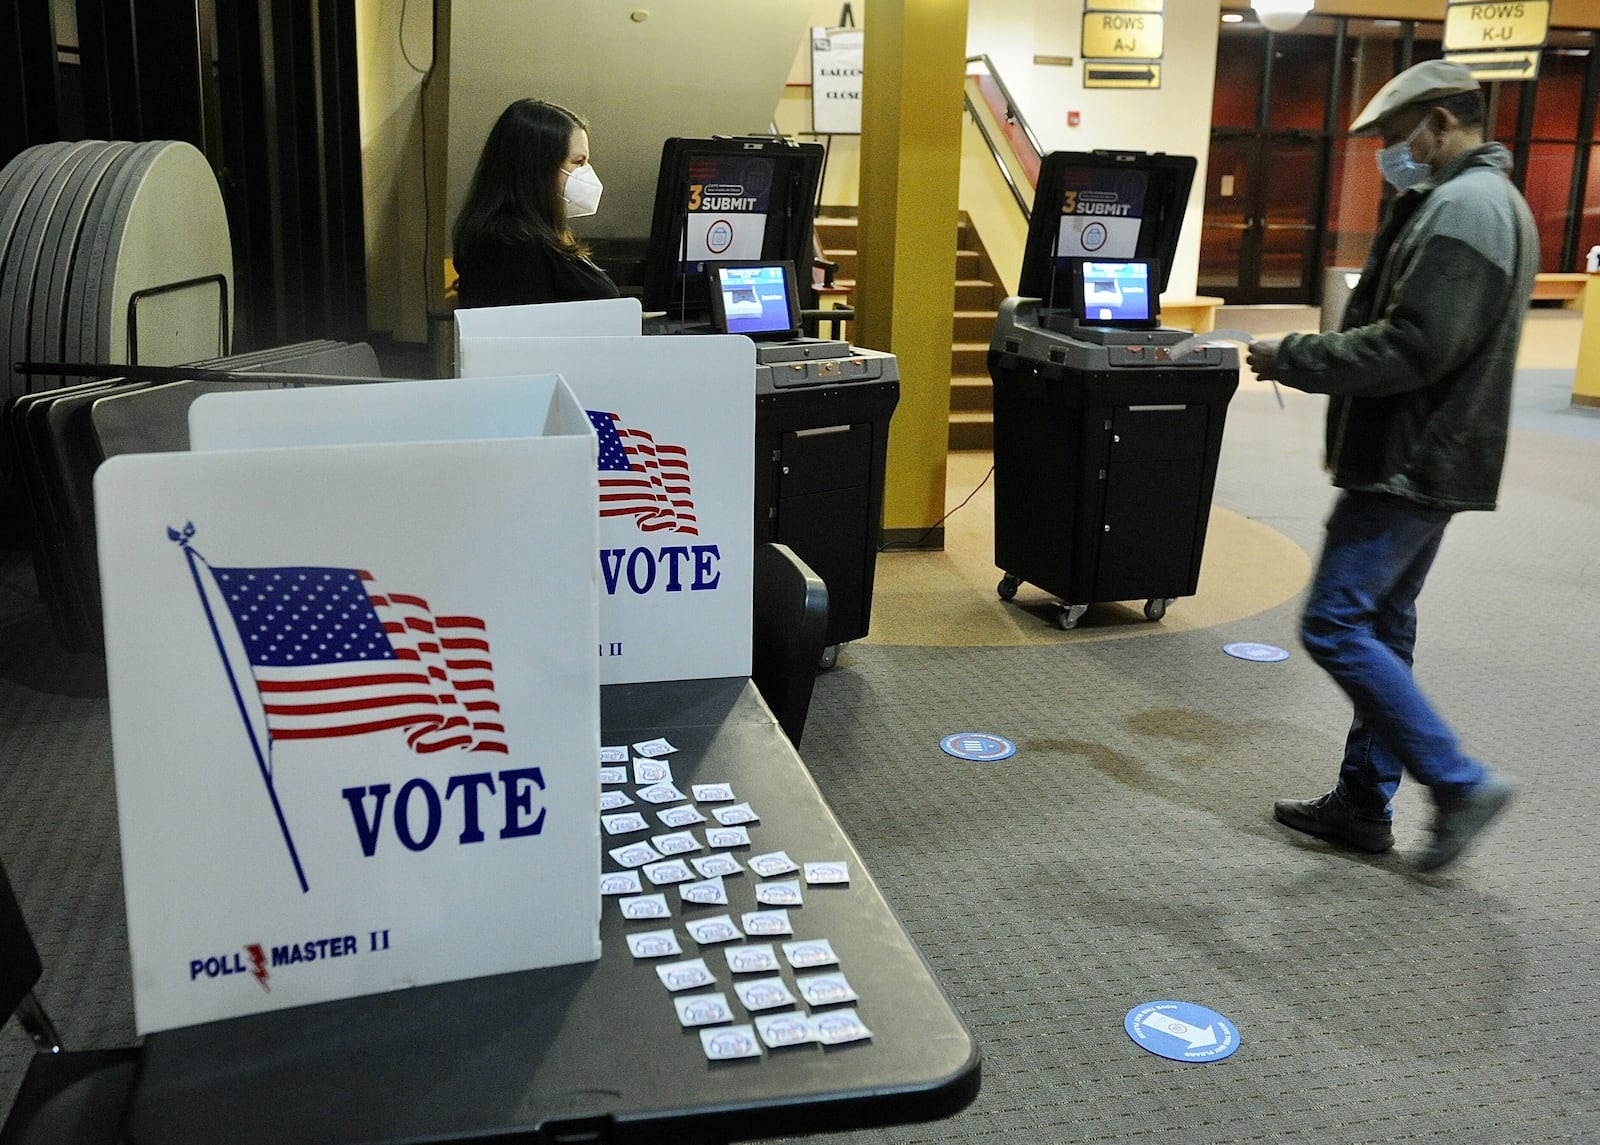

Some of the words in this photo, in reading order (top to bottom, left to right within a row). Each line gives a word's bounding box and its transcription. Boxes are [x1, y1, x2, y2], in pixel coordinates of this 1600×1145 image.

[1102, 15, 1145, 30] ROWS
[1471, 4, 1525, 20] ROWS
[1113, 38, 1136, 52] A-J
[1482, 26, 1513, 41] K-U
[688, 184, 703, 210] 3
[702, 197, 757, 211] SUBMIT
[1062, 191, 1077, 213] 3
[1076, 202, 1131, 216] SUBMIT
[599, 544, 721, 595] VOTE
[341, 766, 547, 858] VOTE
[189, 953, 247, 981] POLL
[271, 936, 358, 967] MASTER
